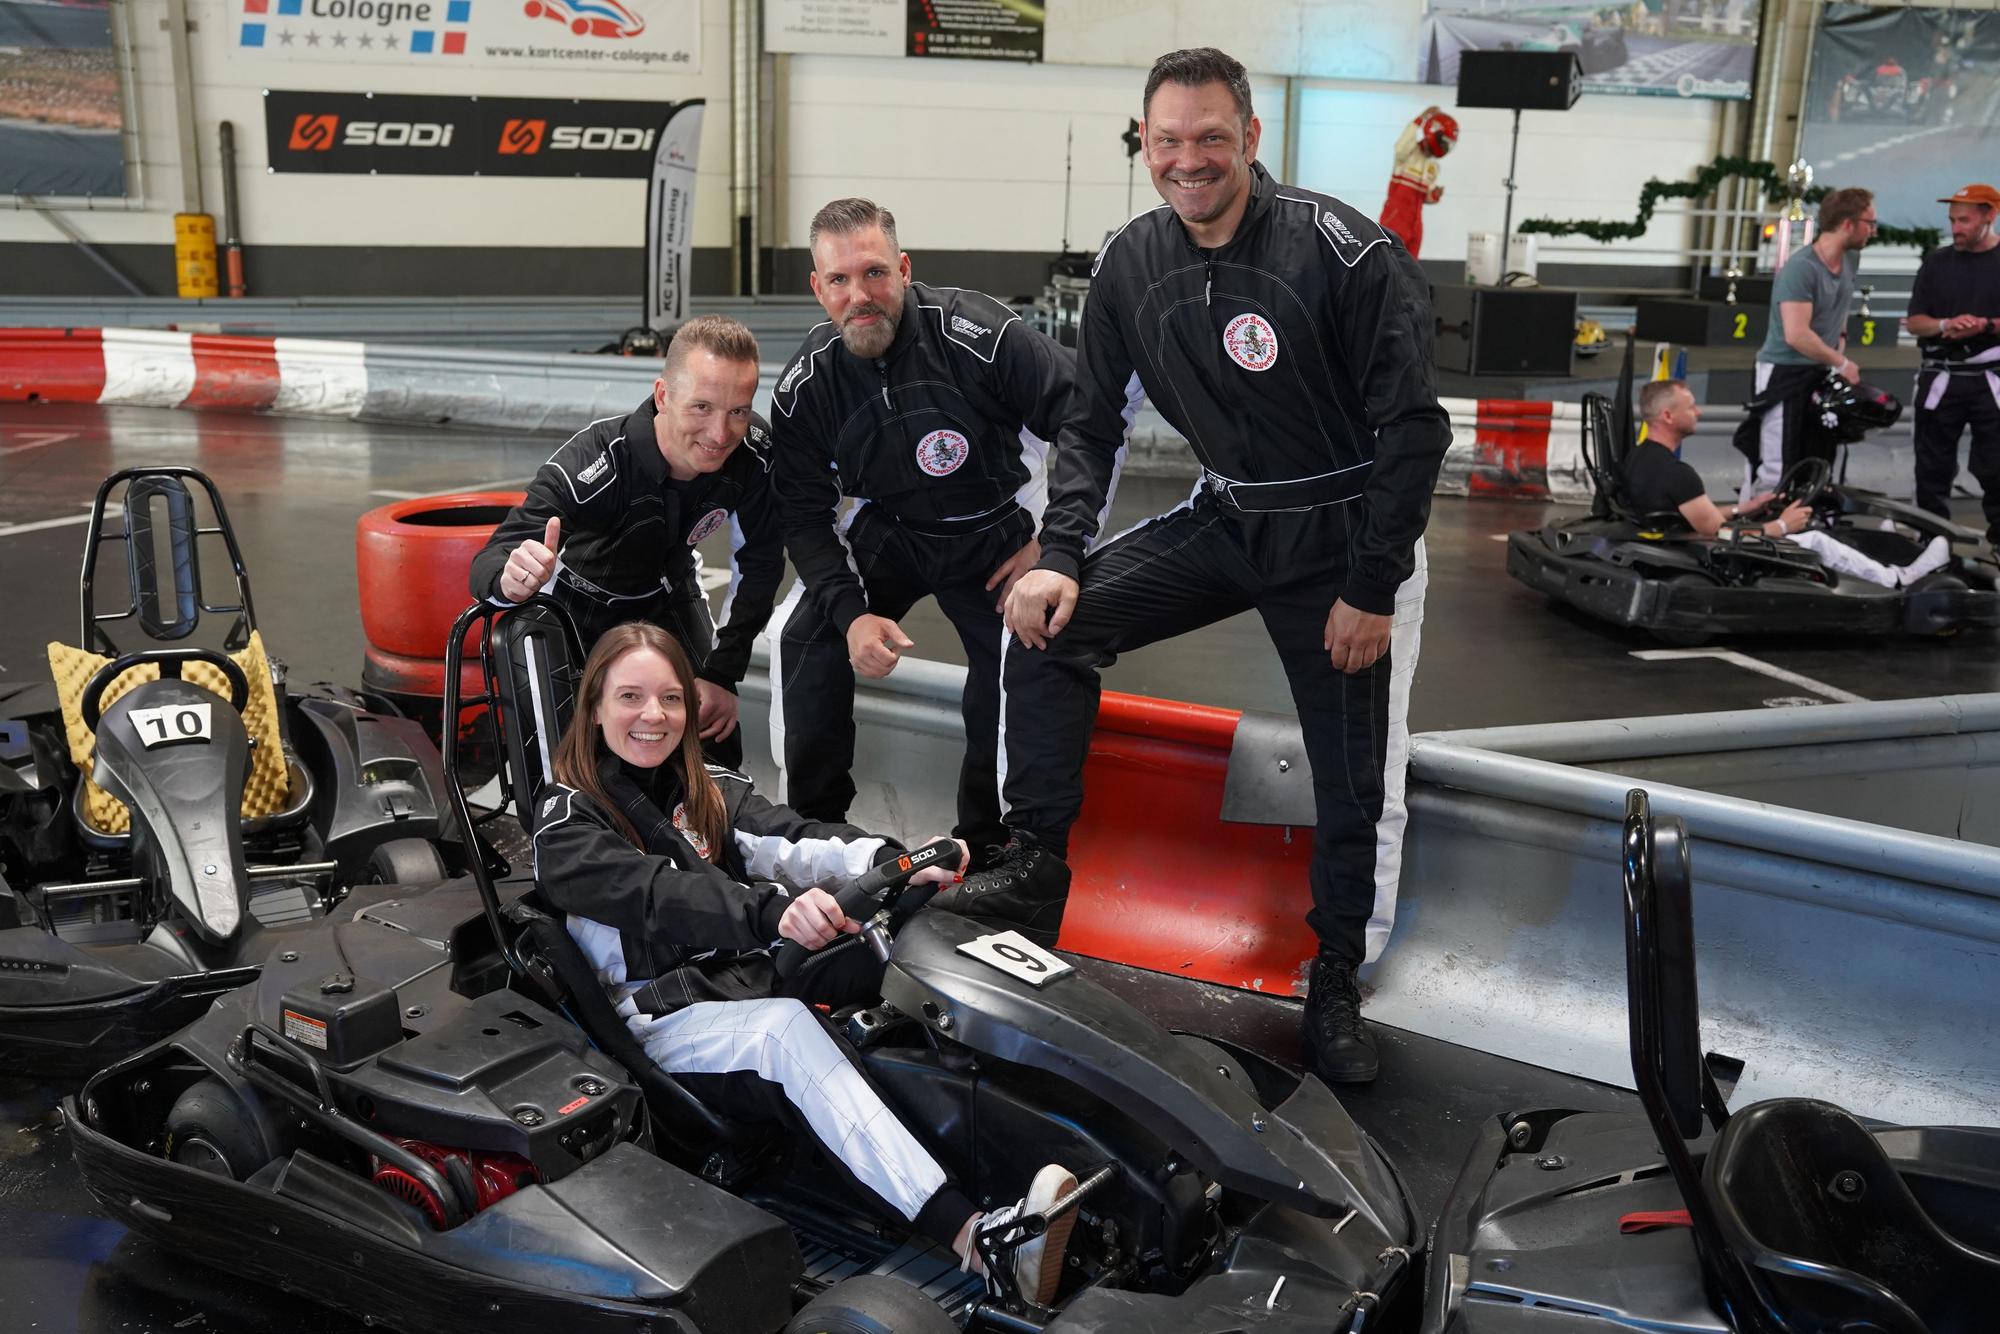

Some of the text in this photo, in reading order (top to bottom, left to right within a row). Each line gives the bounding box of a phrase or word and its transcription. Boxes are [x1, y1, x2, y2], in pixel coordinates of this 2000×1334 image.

[311, 0, 431, 26] Cologne
[485, 45, 690, 63] www.kartcenter-cologne.de
[663, 289, 674, 311] KC
[1733, 313, 1748, 339] 2
[1861, 321, 1875, 345] 3
[146, 710, 203, 739] 10
[910, 847, 937, 864] SODI
[991, 943, 1048, 973] 9
